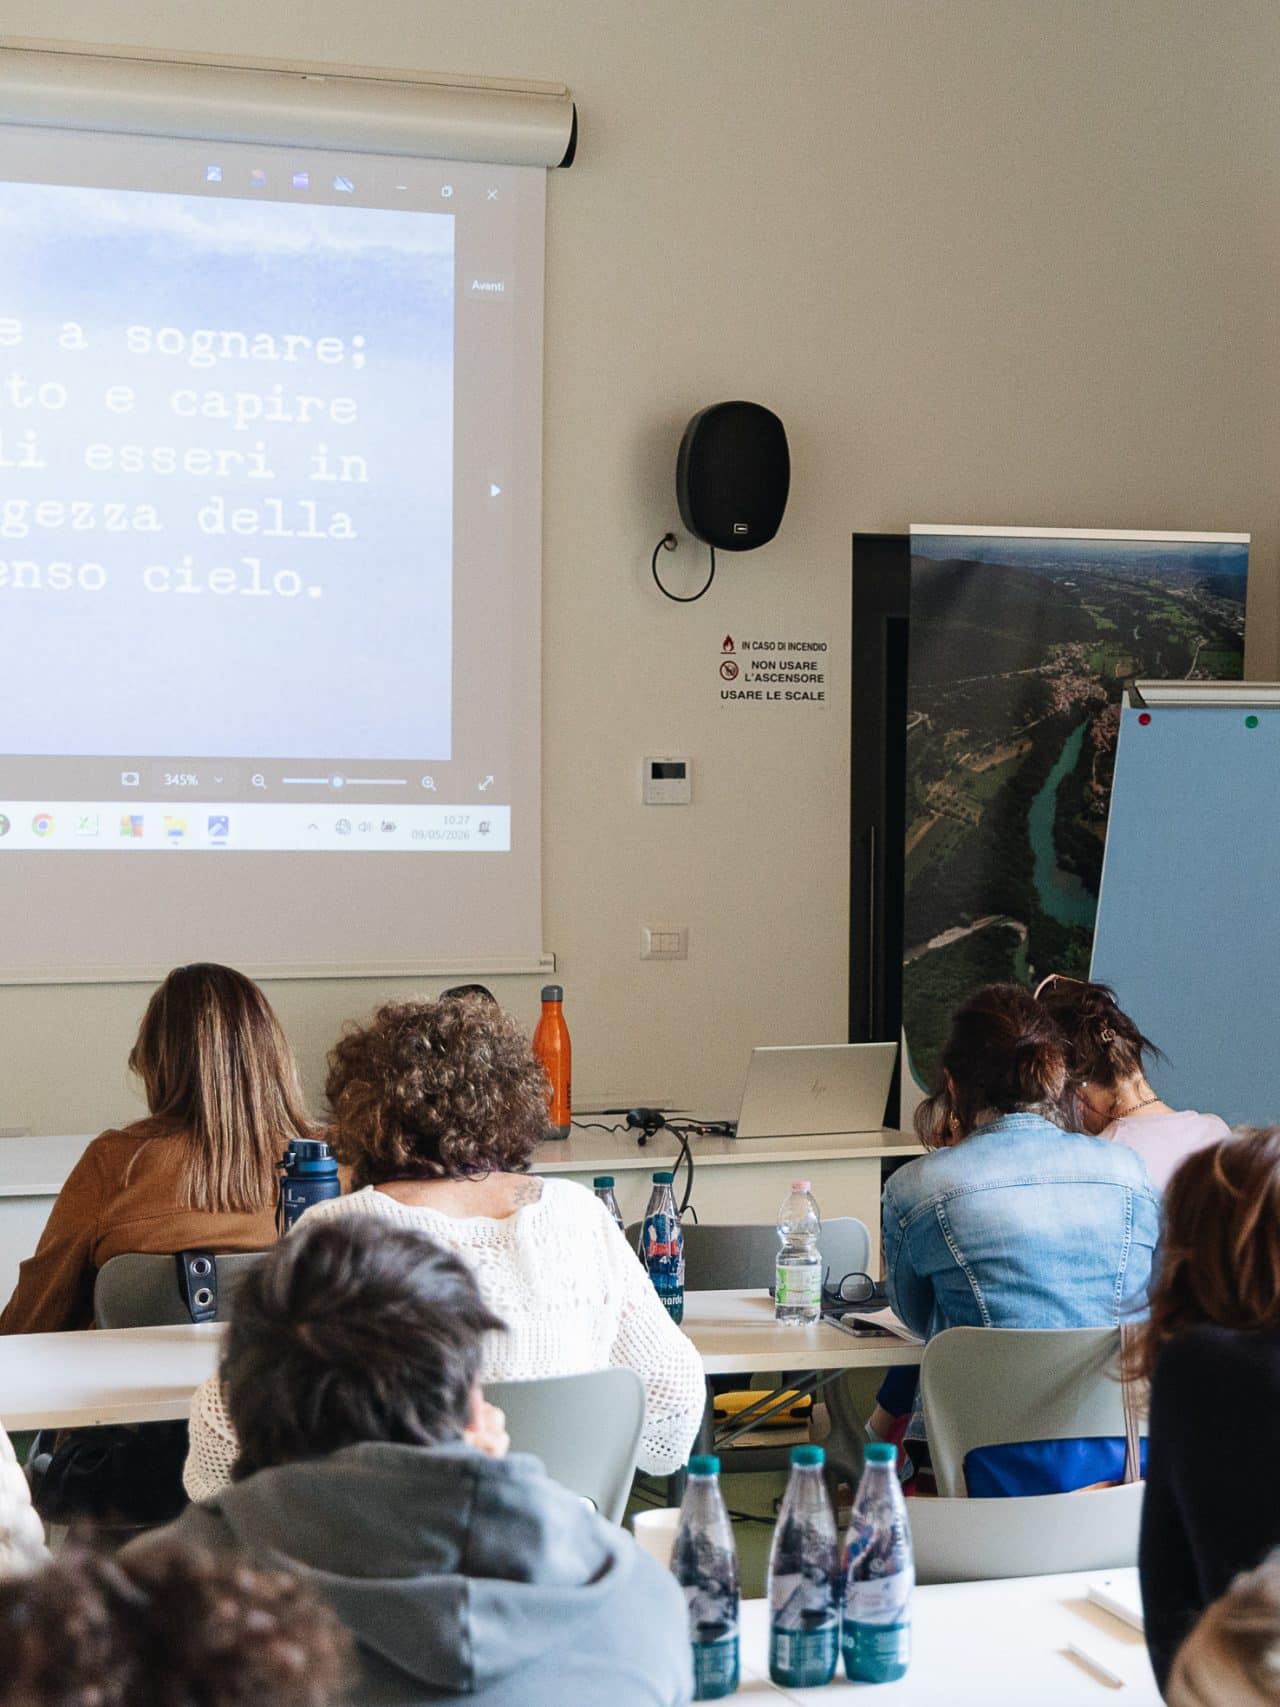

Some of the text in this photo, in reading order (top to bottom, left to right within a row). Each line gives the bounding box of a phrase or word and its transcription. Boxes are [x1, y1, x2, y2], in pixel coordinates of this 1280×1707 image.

[471, 279, 505, 292] Avanti
[59, 321, 89, 350] a
[126, 323, 367, 370] sognare;
[5, 372, 359, 430] to e capire
[85, 441, 276, 480] esseri
[310, 444, 370, 483] in
[0, 496, 358, 540] gezza della
[143, 555, 324, 599] cielo.
[742, 641, 828, 652] IN CASO DI INCENDIO
[751, 660, 818, 671] NON USARE
[744, 673, 825, 683] L'ASCENSORE
[720, 690, 825, 701] USARE LE SCALE
[164, 773, 199, 787] 345%
